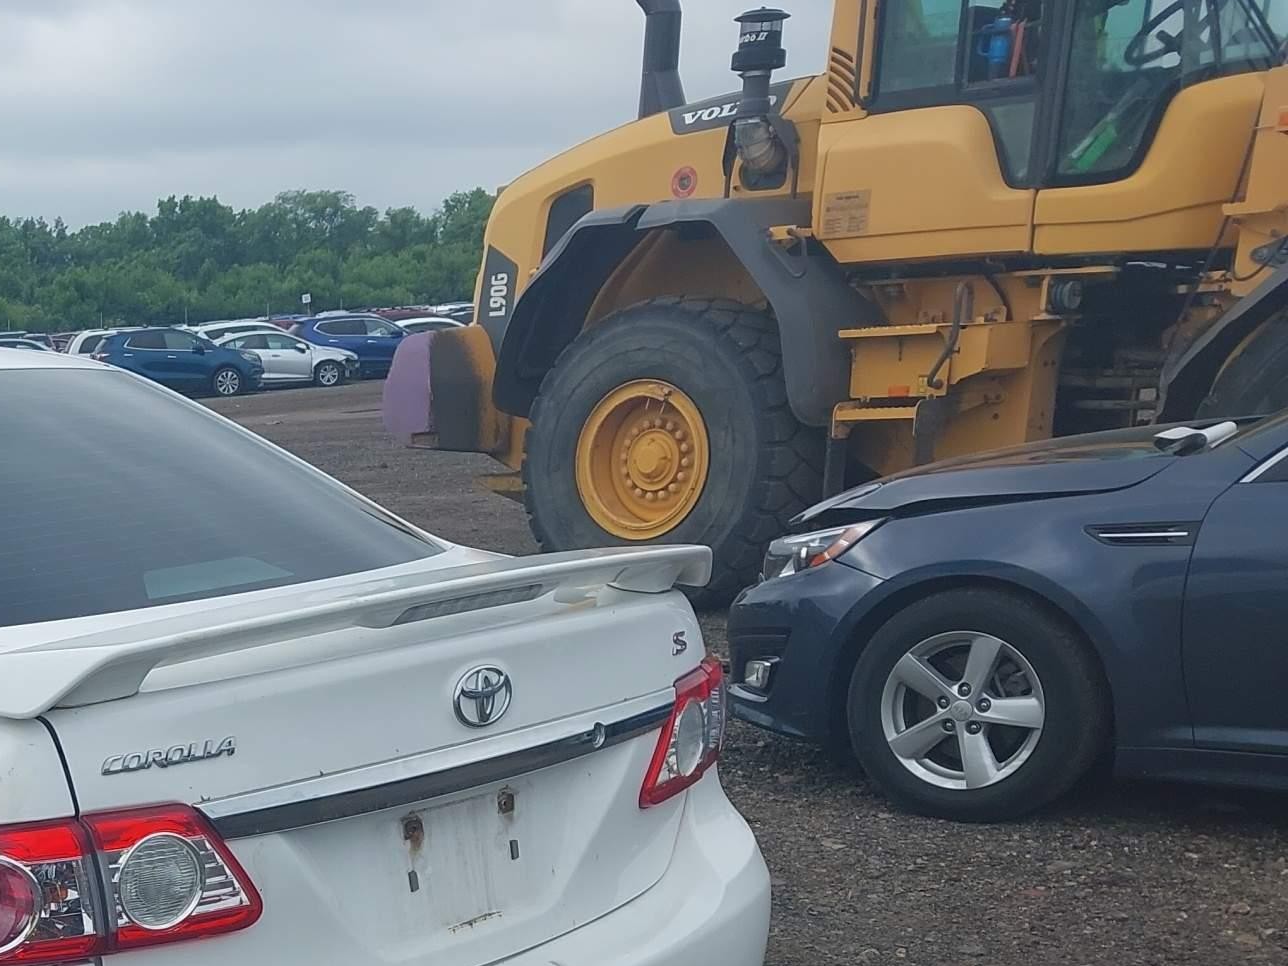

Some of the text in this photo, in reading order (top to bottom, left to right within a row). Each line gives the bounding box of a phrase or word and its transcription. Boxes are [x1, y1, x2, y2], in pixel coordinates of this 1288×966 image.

[682, 96, 777, 125] VOL
[489, 273, 508, 317] L90G
[672, 631, 688, 656] S
[101, 736, 236, 776] COROLLA
